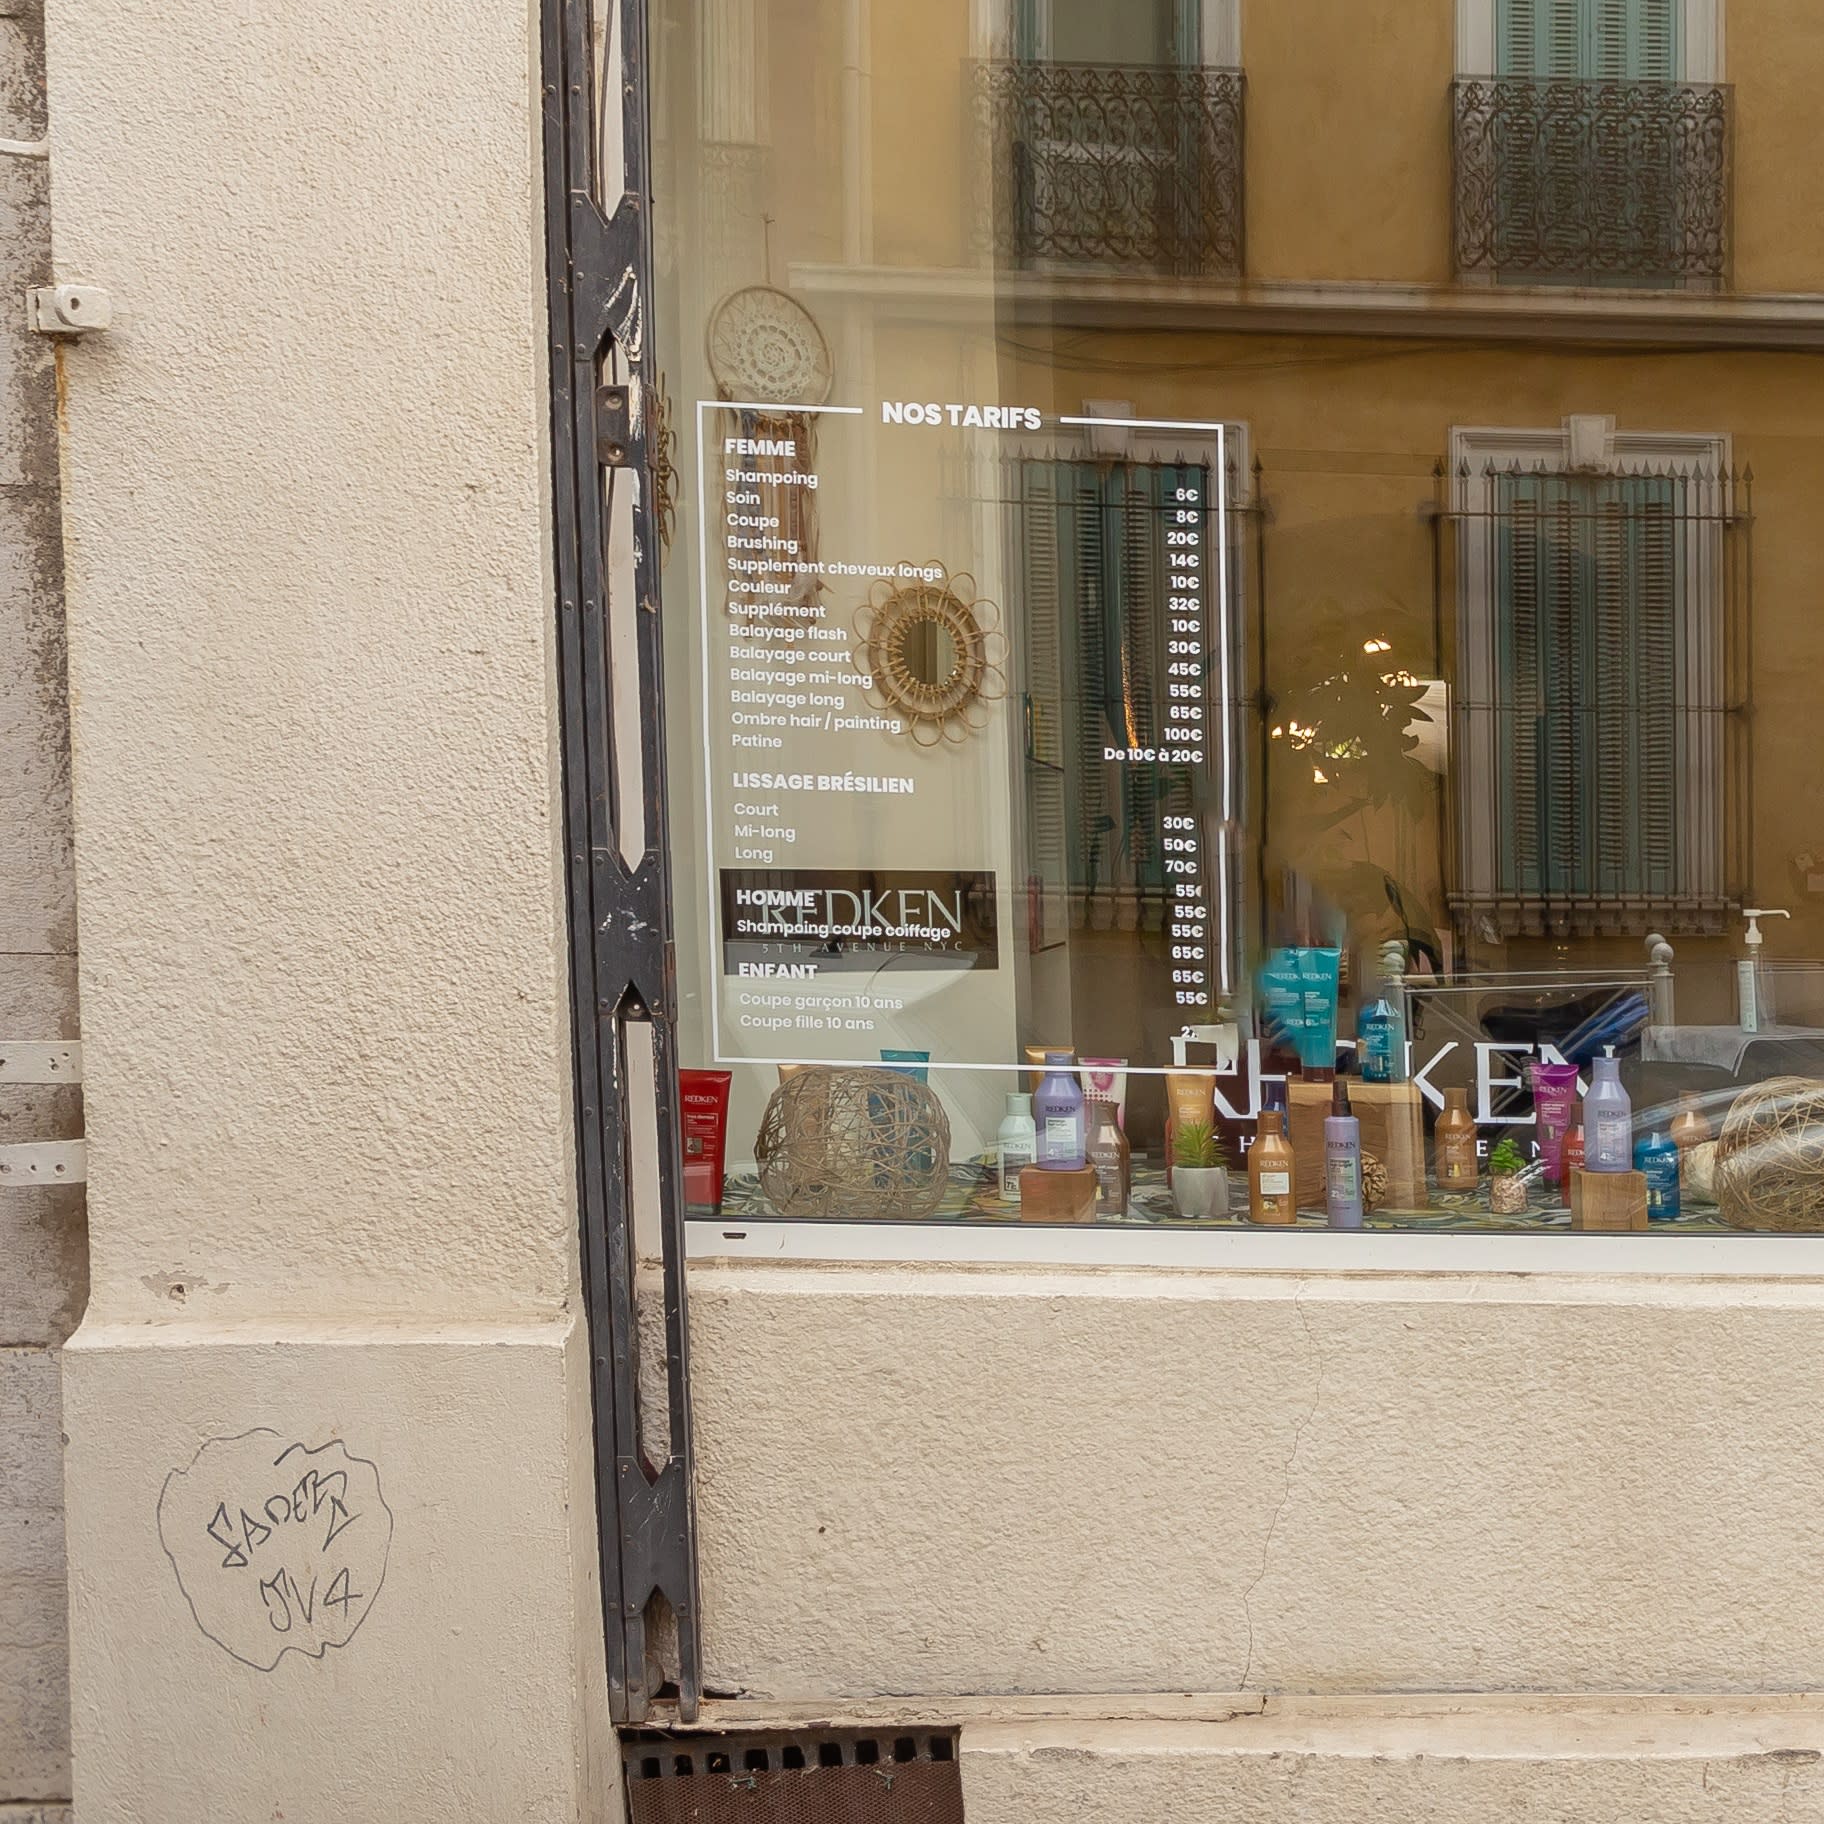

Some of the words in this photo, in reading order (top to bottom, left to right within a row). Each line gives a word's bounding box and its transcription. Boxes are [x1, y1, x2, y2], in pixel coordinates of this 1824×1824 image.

[882, 401, 941, 424] NOS
[947, 404, 1042, 430] TARIFS
[725, 438, 796, 457] FEMME
[726, 469, 818, 489] Shampoing
[726, 491, 760, 505] Soin
[1176, 488, 1198, 502] 6€
[727, 513, 779, 530] Coupe
[1176, 510, 1198, 524] 8€
[727, 535, 798, 554] Brushing
[1167, 532, 1199, 546] 20€
[1170, 554, 1199, 567] 14€
[727, 557, 825, 576] Supplement
[828, 560, 895, 577] cheveux
[899, 564, 942, 581] longs
[728, 579, 791, 594] Couleur
[1170, 576, 1200, 589] 10€
[728, 602, 826, 619] Supplément
[1169, 598, 1200, 611] 32€
[729, 624, 805, 642] Balayage
[807, 626, 847, 640] flash
[1172, 620, 1200, 633] 10€
[1168, 641, 1200, 654] 30€
[730, 646, 805, 664] Balayage
[808, 650, 851, 663] court
[1168, 663, 1201, 676] 45€
[730, 668, 806, 686] Balayage
[809, 670, 872, 689] mi-long
[1169, 684, 1202, 698] 55€
[731, 689, 806, 708] Balayage
[809, 692, 844, 709] long
[1170, 706, 1202, 720] 65€
[732, 712, 786, 726] Ombre
[790, 714, 821, 727] hair
[824, 713, 832, 730] /
[834, 716, 900, 733] painting
[732, 735, 782, 748] Patine
[1164, 728, 1202, 741] 100€
[1104, 748, 1125, 761] De
[1127, 748, 1155, 761] 10€
[1159, 748, 1169, 762] à
[1172, 750, 1203, 763] 20€
[733, 772, 813, 791] LISSAGE
[818, 771, 913, 793] BRÉSILIEN
[734, 803, 778, 816] Court
[1164, 817, 1194, 830] 30€
[734, 825, 795, 842] Mi-long
[1164, 839, 1196, 851] 50€
[735, 846, 773, 863] Long
[1165, 861, 1197, 874] 70€
[737, 890, 814, 907] HOMME
[761, 889, 962, 934] REDKEN
[1174, 906, 1206, 918] 55€
[737, 919, 828, 938] Shampoing
[832, 924, 881, 940] coupe
[885, 924, 951, 942] coiffage
[1172, 926, 1204, 938] 55€
[762, 943, 802, 954] 5TH
[821, 941, 906, 952] AVENUE
[924, 941, 963, 952] NYC
[1172, 947, 1204, 959] 65€
[739, 962, 817, 979] ENFANT
[1172, 971, 1204, 983] 65€
[739, 993, 791, 1009] Coupe
[795, 996, 851, 1011] garçon
[855, 996, 870, 1008] 10
[874, 997, 903, 1009] ans
[1176, 992, 1208, 1004] 55€
[740, 1015, 792, 1031] Coupe
[796, 1015, 823, 1028] fille
[826, 1017, 841, 1028] 10
[845, 1018, 874, 1030] ans
[1177, 1088, 1206, 1096] REDKEN
[1260, 1160, 1288, 1168] REDKEN
